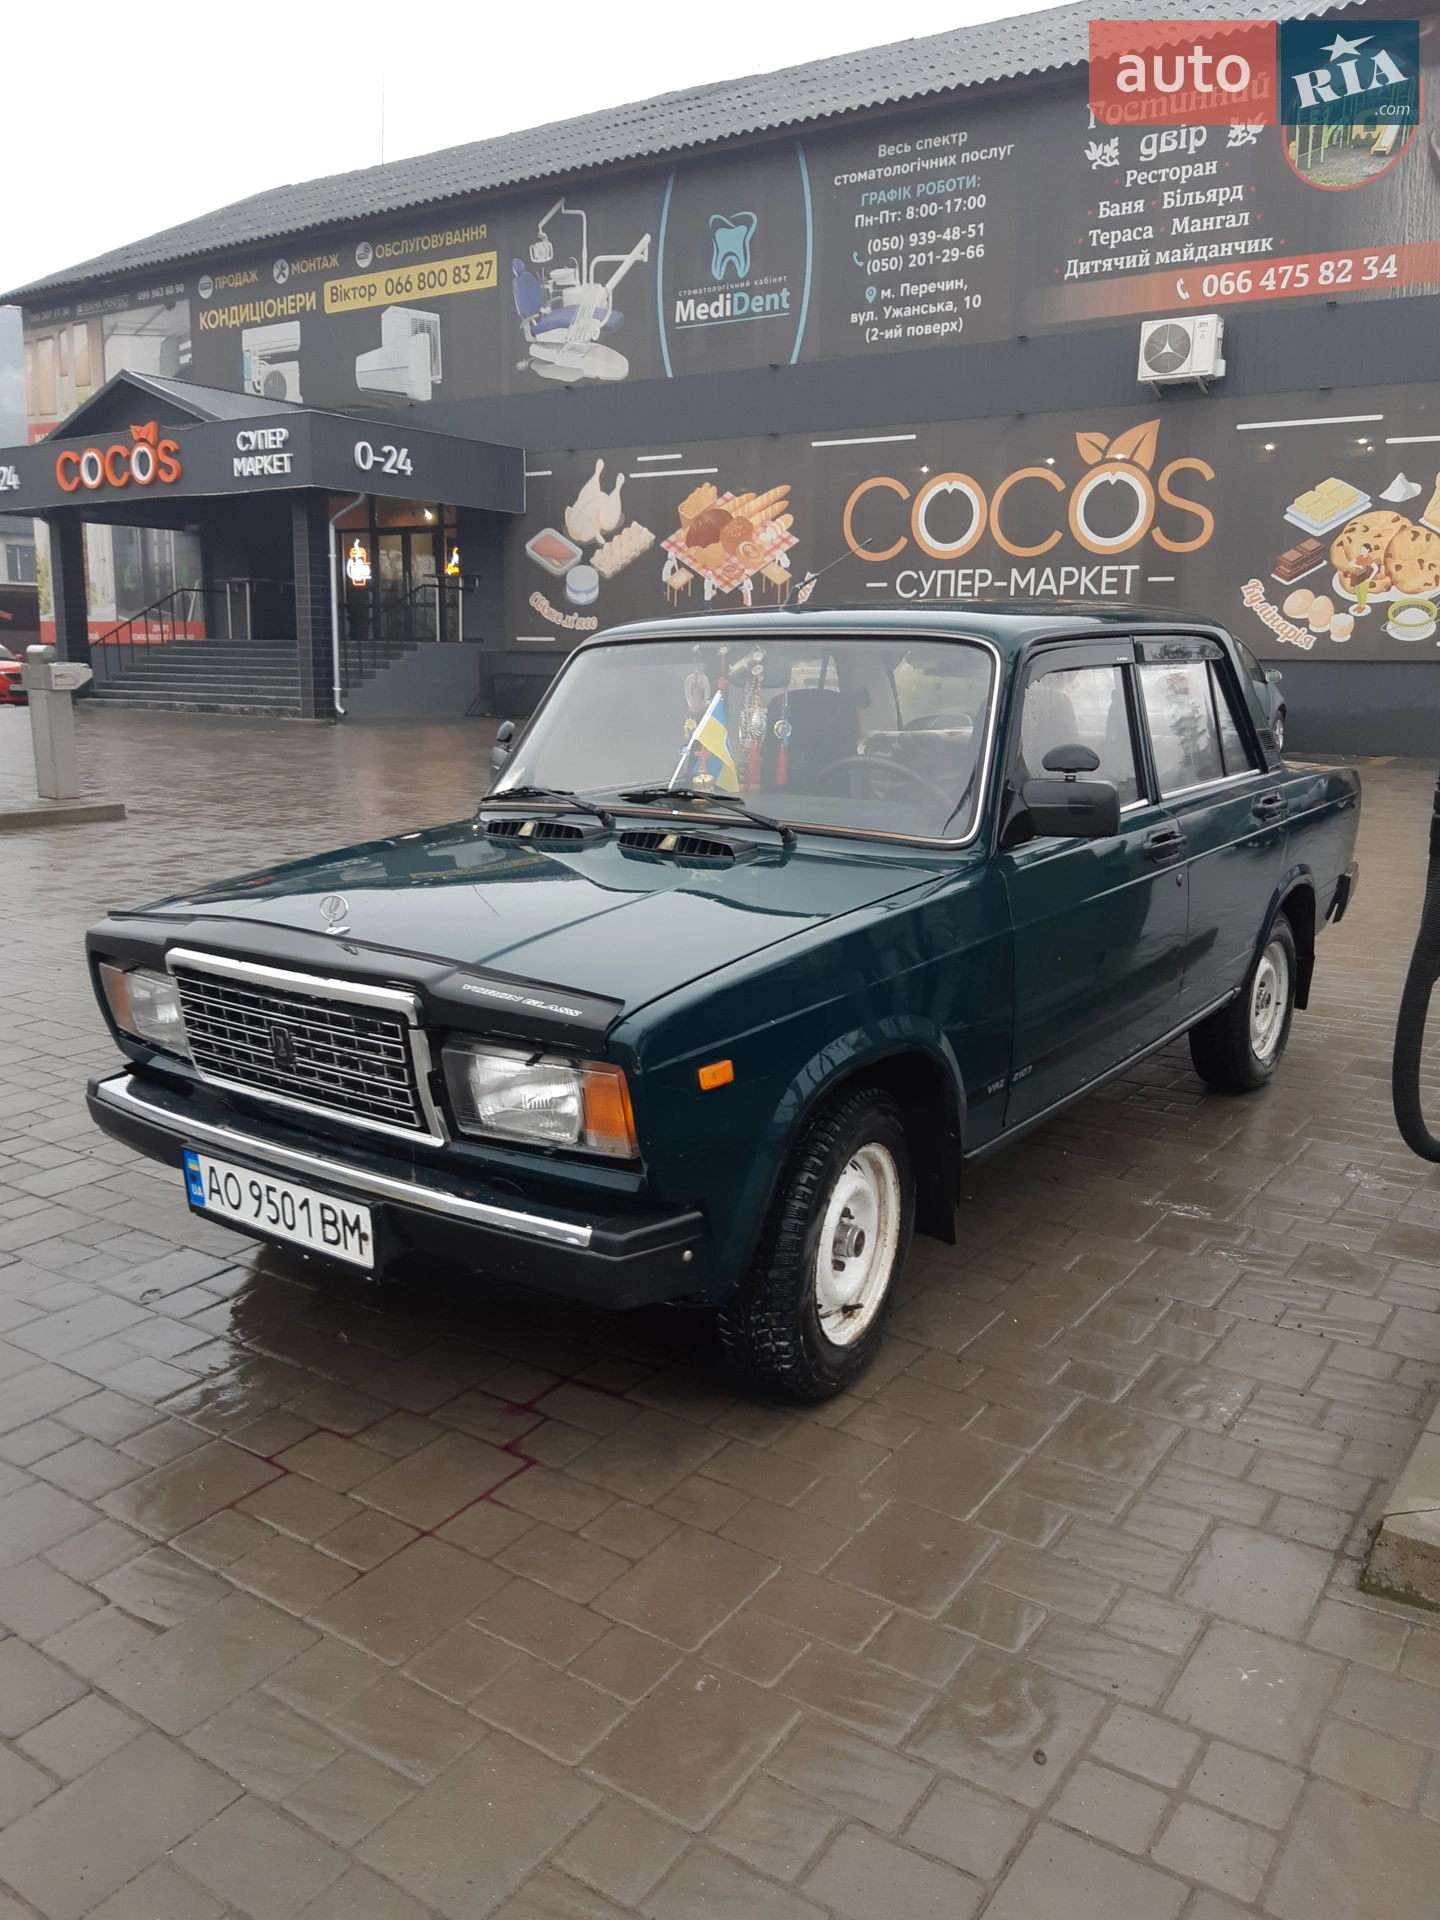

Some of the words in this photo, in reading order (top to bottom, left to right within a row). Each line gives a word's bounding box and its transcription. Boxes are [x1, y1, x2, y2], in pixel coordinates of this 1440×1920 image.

[877, 142, 912, 158] Весь
[915, 131, 969, 151] спектр
[1139, 123, 1207, 162] двір
[833, 154, 957, 187] стоматологічних
[961, 144, 1015, 164] послуг
[1124, 160, 1218, 188] Ресторан
[861, 186, 912, 206] ГРАФІК
[916, 174, 981, 198] РОБОТИ:
[1098, 199, 1145, 219] Баня
[1162, 184, 1244, 210] Більярд
[854, 209, 902, 228] Пн-Пт:
[905, 194, 987, 220] 8:00-17:00
[867, 234, 904, 255] (050)
[909, 222, 985, 247] 939-48-51
[1088, 225, 1154, 249] Тераса
[1170, 211, 1250, 236] Мангал
[214, 269, 259, 290] ПРОДАЖ
[291, 253, 340, 275] МОНТАЖ
[375, 224, 488, 259] ОБСЛУГОВУВАННЯ
[866, 255, 904, 275] (050)
[908, 244, 985, 268] 201-29-66
[1064, 249, 1151, 280] Дитячий
[1154, 237, 1274, 265] майданчик
[330, 282, 377, 303] Віктор
[385, 275, 413, 296] 066
[417, 268, 448, 291] 800
[452, 264, 471, 285] 83
[475, 259, 493, 281] 27
[678, 279, 751, 297] стоматологічний
[753, 275, 788, 286] кабінет
[880, 288, 896, 300] м.
[900, 278, 969, 298] Перечин,
[1202, 270, 1253, 298] 066
[1259, 263, 1310, 291] 475
[1317, 258, 1353, 285] 82
[1361, 253, 1398, 281] 34
[199, 291, 317, 330] КОНДИЦІОНЕРИ
[675, 287, 790, 323] MediDent
[850, 309, 879, 326] вул.
[883, 299, 958, 320] Ужанська,
[963, 294, 982, 310] 10
[865, 323, 903, 343] (2-ий
[907, 316, 964, 337] поверх)
[236, 428, 289, 451] СУПЕР
[56, 439, 182, 492] COCOS
[232, 453, 293, 477] МАРКЕТ
[354, 441, 414, 476] 0-24
[843, 457, 1215, 562] COCOS
[895, 564, 1140, 599] СУПЕР-МАРКЕТ
[1240, 578, 1317, 650] Кулінарія
[191, 1183, 204, 1199] UA
[207, 1165, 242, 1211] AO
[249, 1180, 314, 1239] 9501
[319, 1202, 365, 1256] BM
